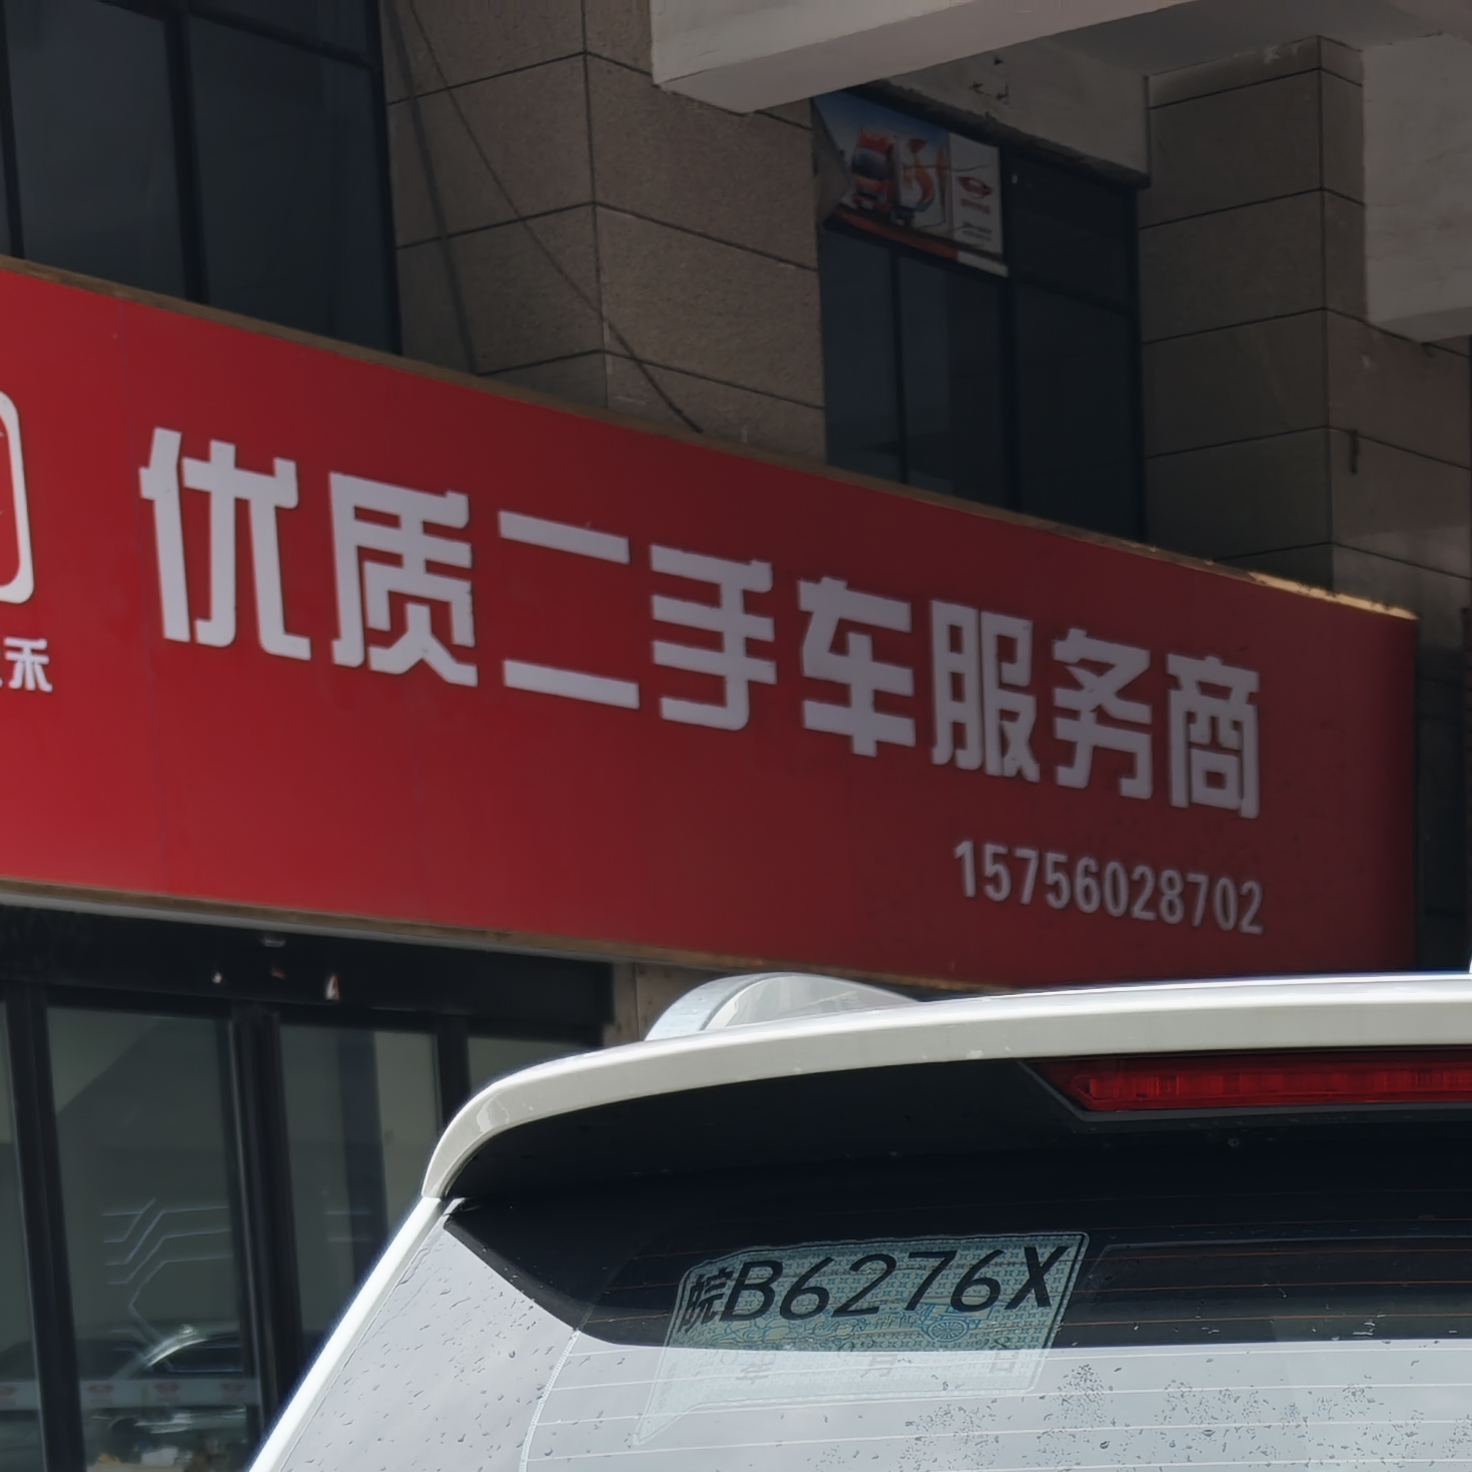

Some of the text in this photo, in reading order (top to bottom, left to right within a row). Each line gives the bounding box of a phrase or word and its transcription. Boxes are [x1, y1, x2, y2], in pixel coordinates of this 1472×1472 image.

[139, 427, 1259, 818] 优质二手车服务商
[954, 840, 1264, 934] 15756028702
[679, 1245, 1069, 1332] 皖B6276X
